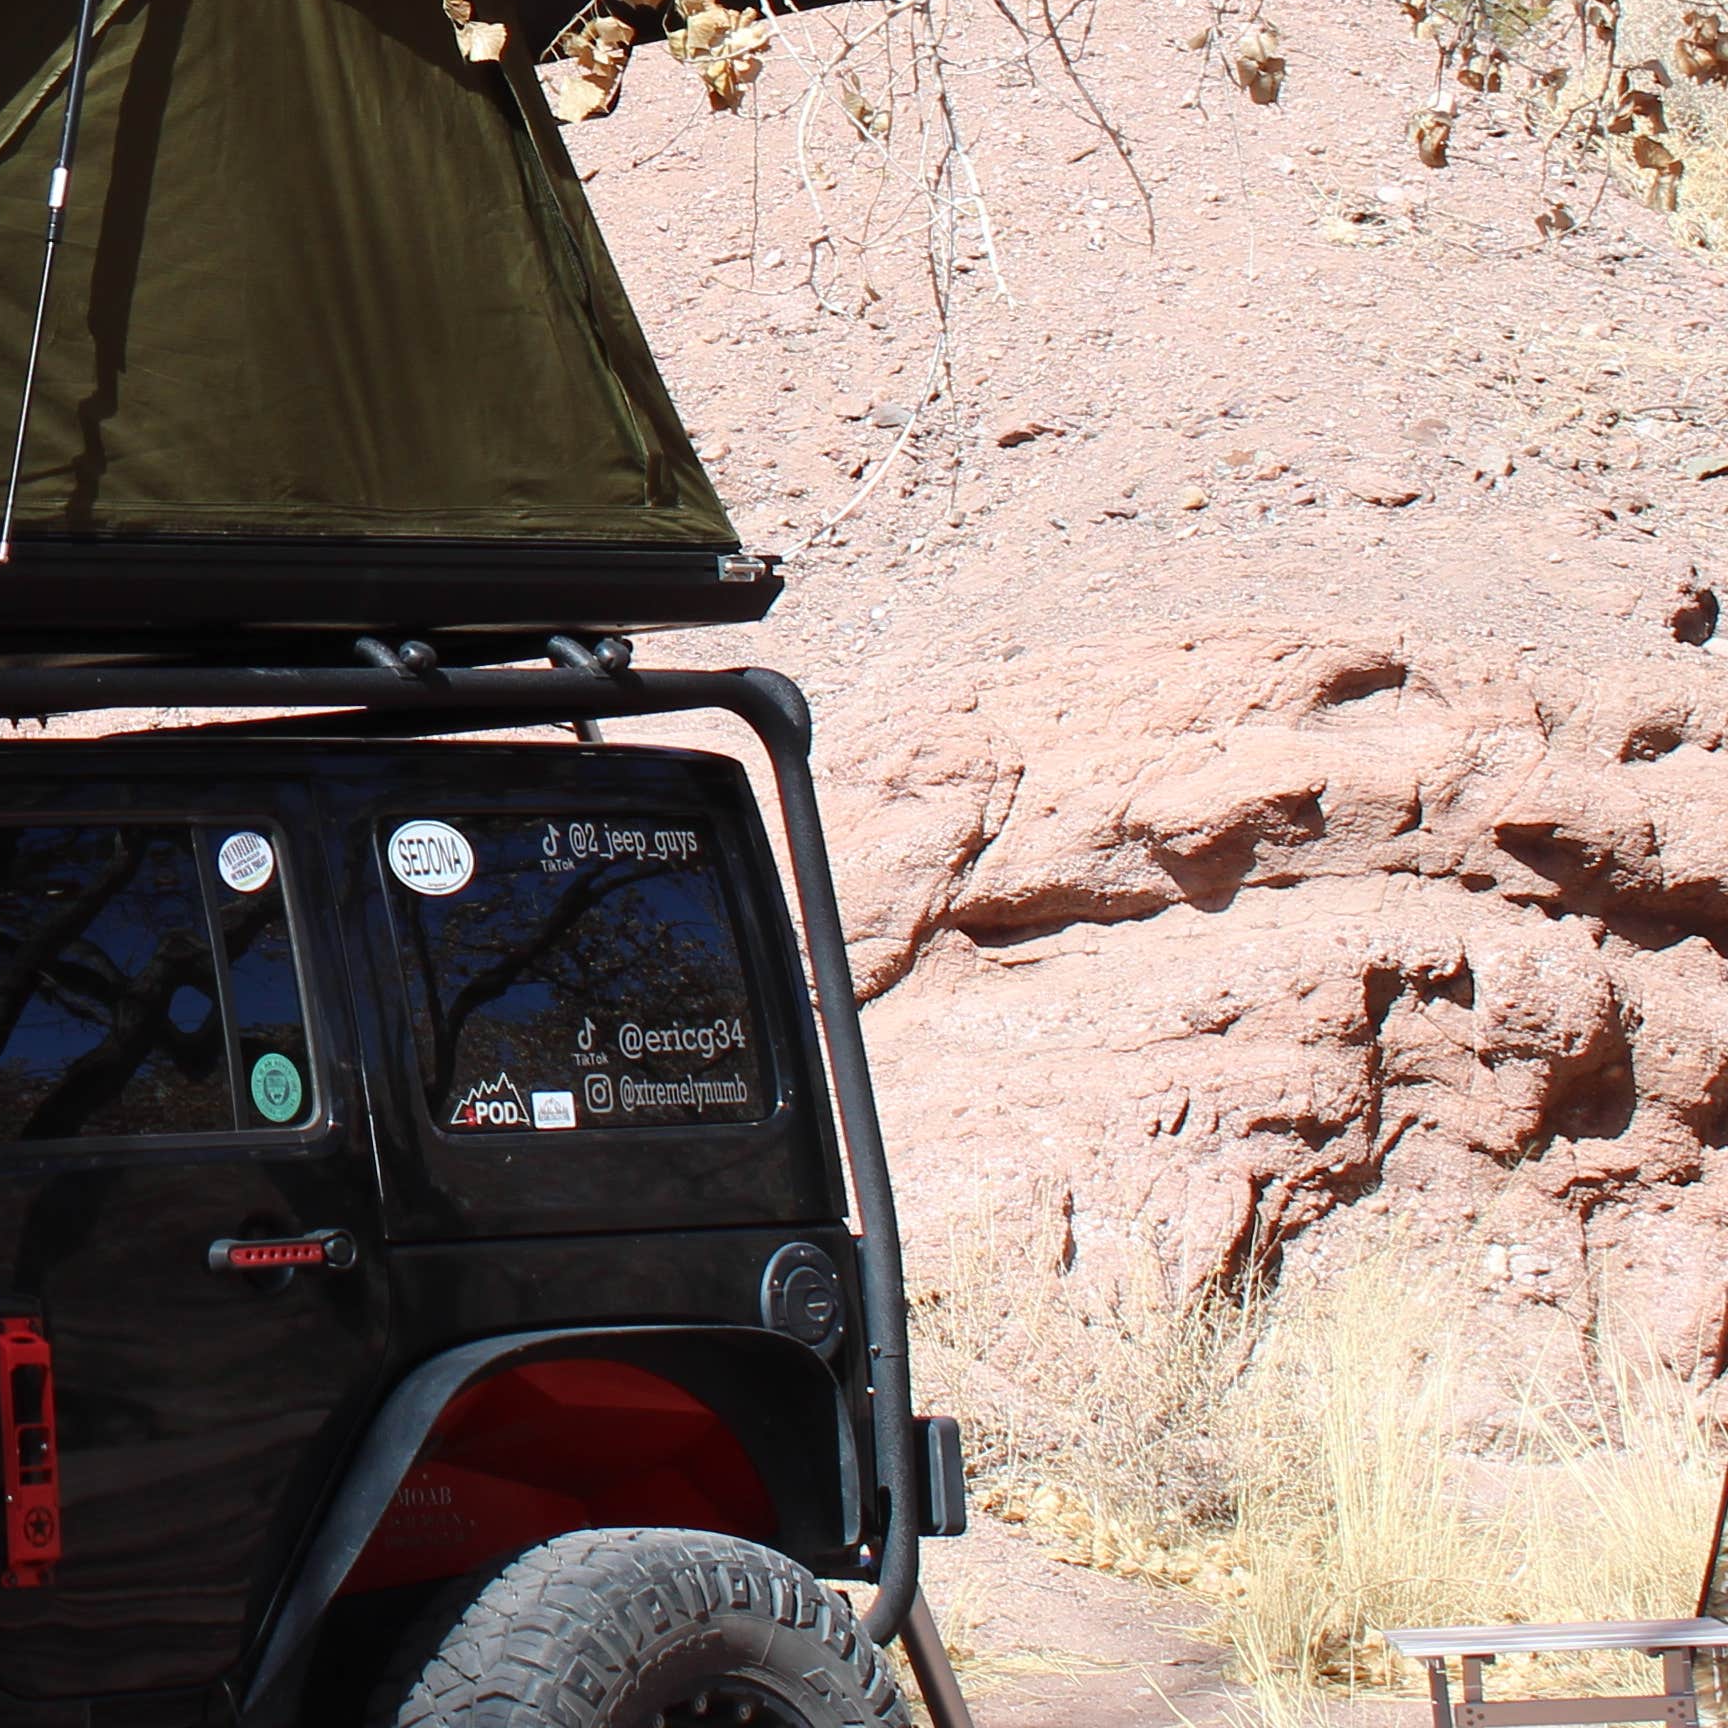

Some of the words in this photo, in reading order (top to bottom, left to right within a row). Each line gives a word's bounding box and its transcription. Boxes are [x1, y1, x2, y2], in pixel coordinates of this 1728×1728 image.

[397, 836, 467, 877] SEDONA
[568, 822, 699, 860] @2_jeep_guys
[540, 858, 576, 873] TikTok
[618, 1018, 747, 1059] @ericg34
[572, 1051, 609, 1067] TikTok
[619, 1073, 748, 1113] @xtremelynumb
[475, 1101, 519, 1125] POD
[396, 1486, 452, 1506] MOAB
